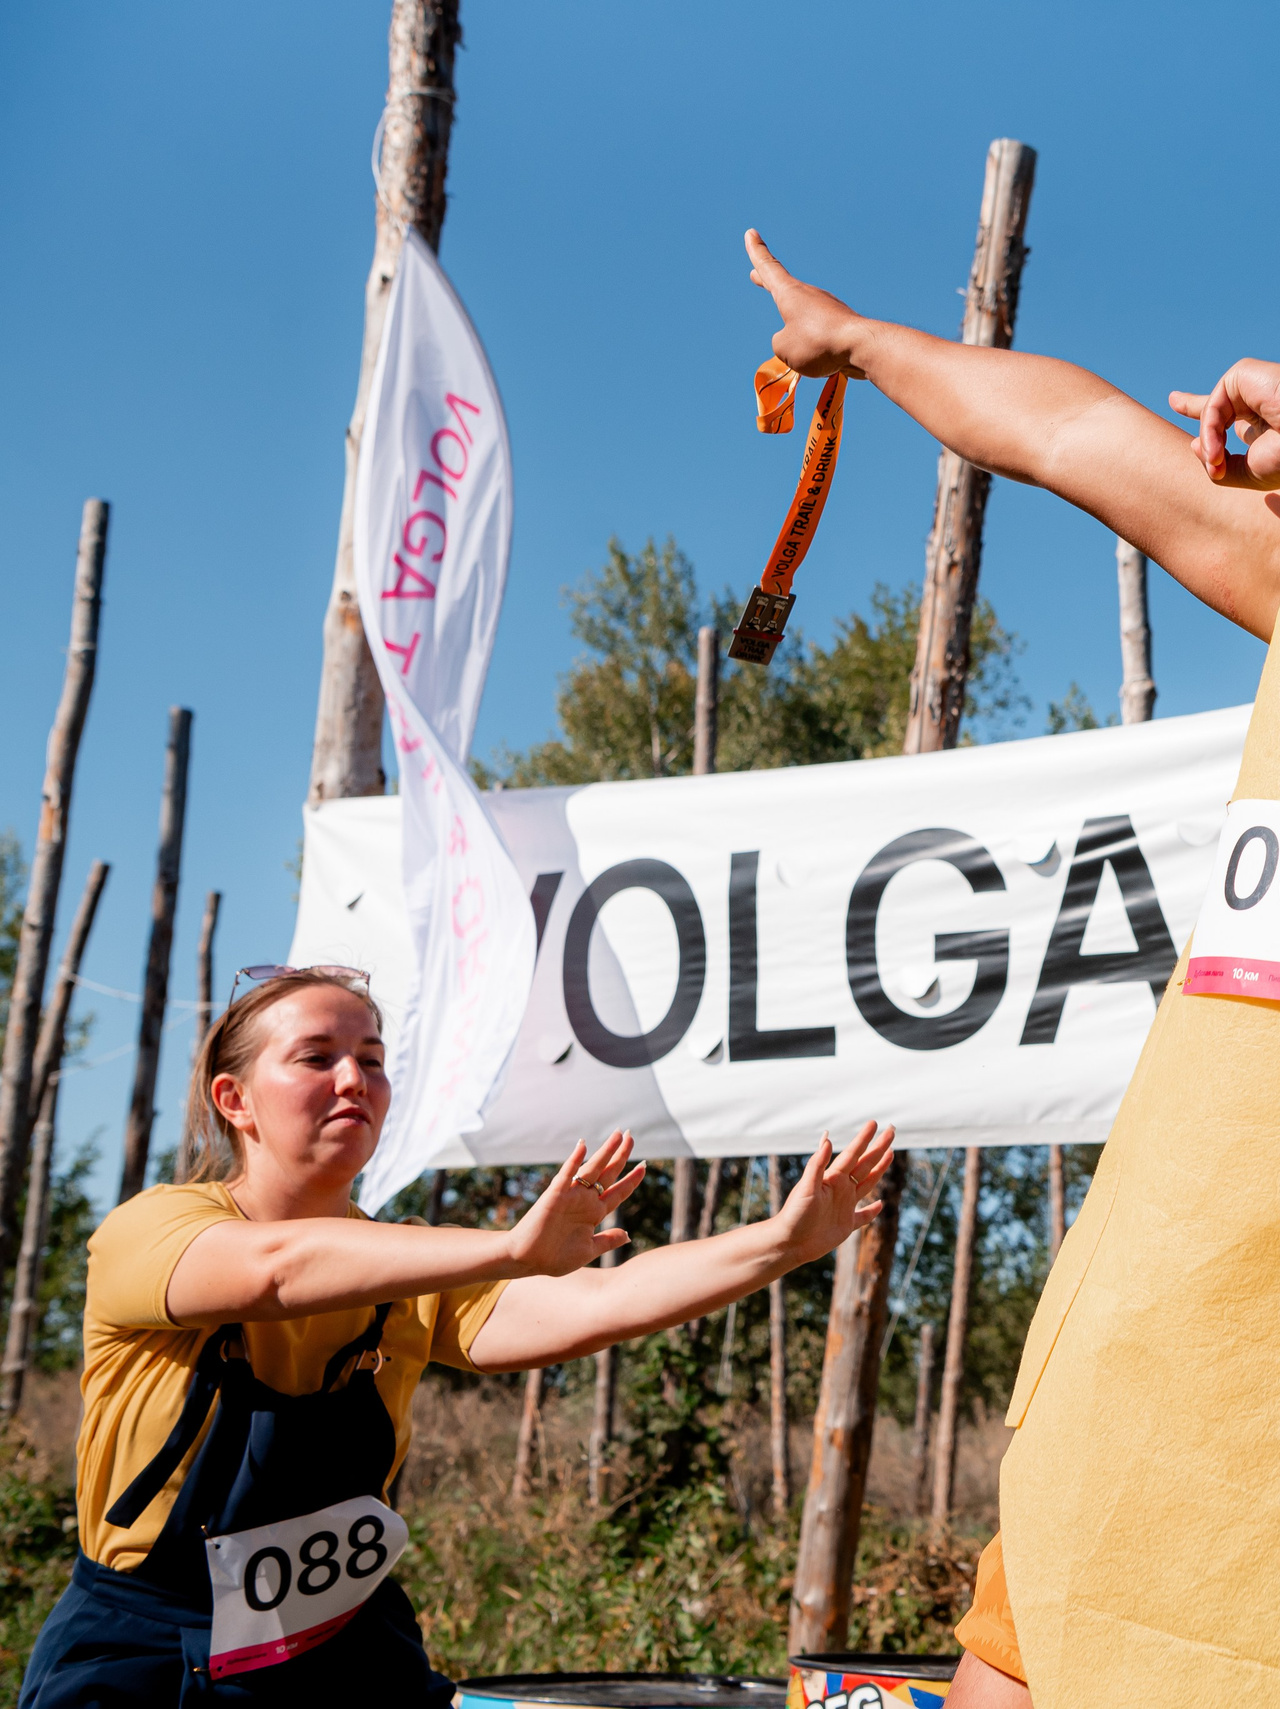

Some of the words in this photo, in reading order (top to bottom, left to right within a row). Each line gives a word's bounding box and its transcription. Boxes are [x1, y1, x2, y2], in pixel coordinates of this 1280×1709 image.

[812, 436, 837, 482] DRINK
[381, 392, 480, 600] VOLGA
[807, 486, 822, 496] &
[790, 500, 817, 537] TRAIL
[771, 541, 801, 578] VOLGA
[1232, 967, 1244, 980] 10
[244, 1514, 388, 1612] 088
[275, 1644, 286, 1654] 10
